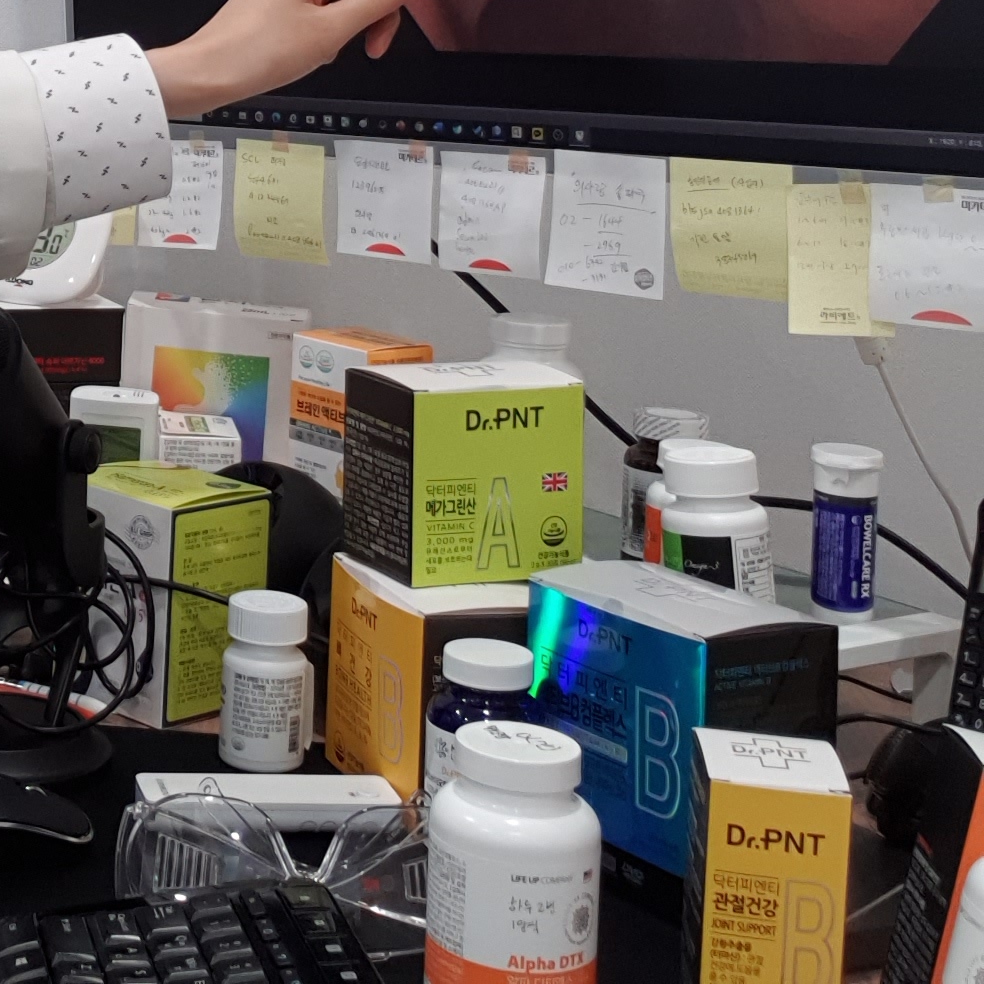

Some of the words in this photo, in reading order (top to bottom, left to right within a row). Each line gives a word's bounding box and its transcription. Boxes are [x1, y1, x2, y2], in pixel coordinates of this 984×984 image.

[296, 399, 320, 418] 브레인
[466, 406, 544, 431] Dr.PNT
[426, 483, 476, 497] 닥터피엔티
[426, 497, 476, 516] 메가그린산
[426, 523, 465, 531] VITAMIN
[468, 521, 475, 529] C
[578, 618, 634, 656] Dr.PNT
[541, 654, 628, 711] 닥터피엔티
[635, 685, 680, 819] B
[730, 744, 808, 760] Dr.PNT
[726, 823, 825, 857] Dr.PNT
[713, 873, 779, 896] 닥터피엔티
[713, 892, 779, 918] 관절건강
[711, 917, 735, 932] JOINT
[736, 921, 776, 936] SUPPORT
[507, 954, 556, 975] Alpha
[560, 951, 584, 969] DTX
